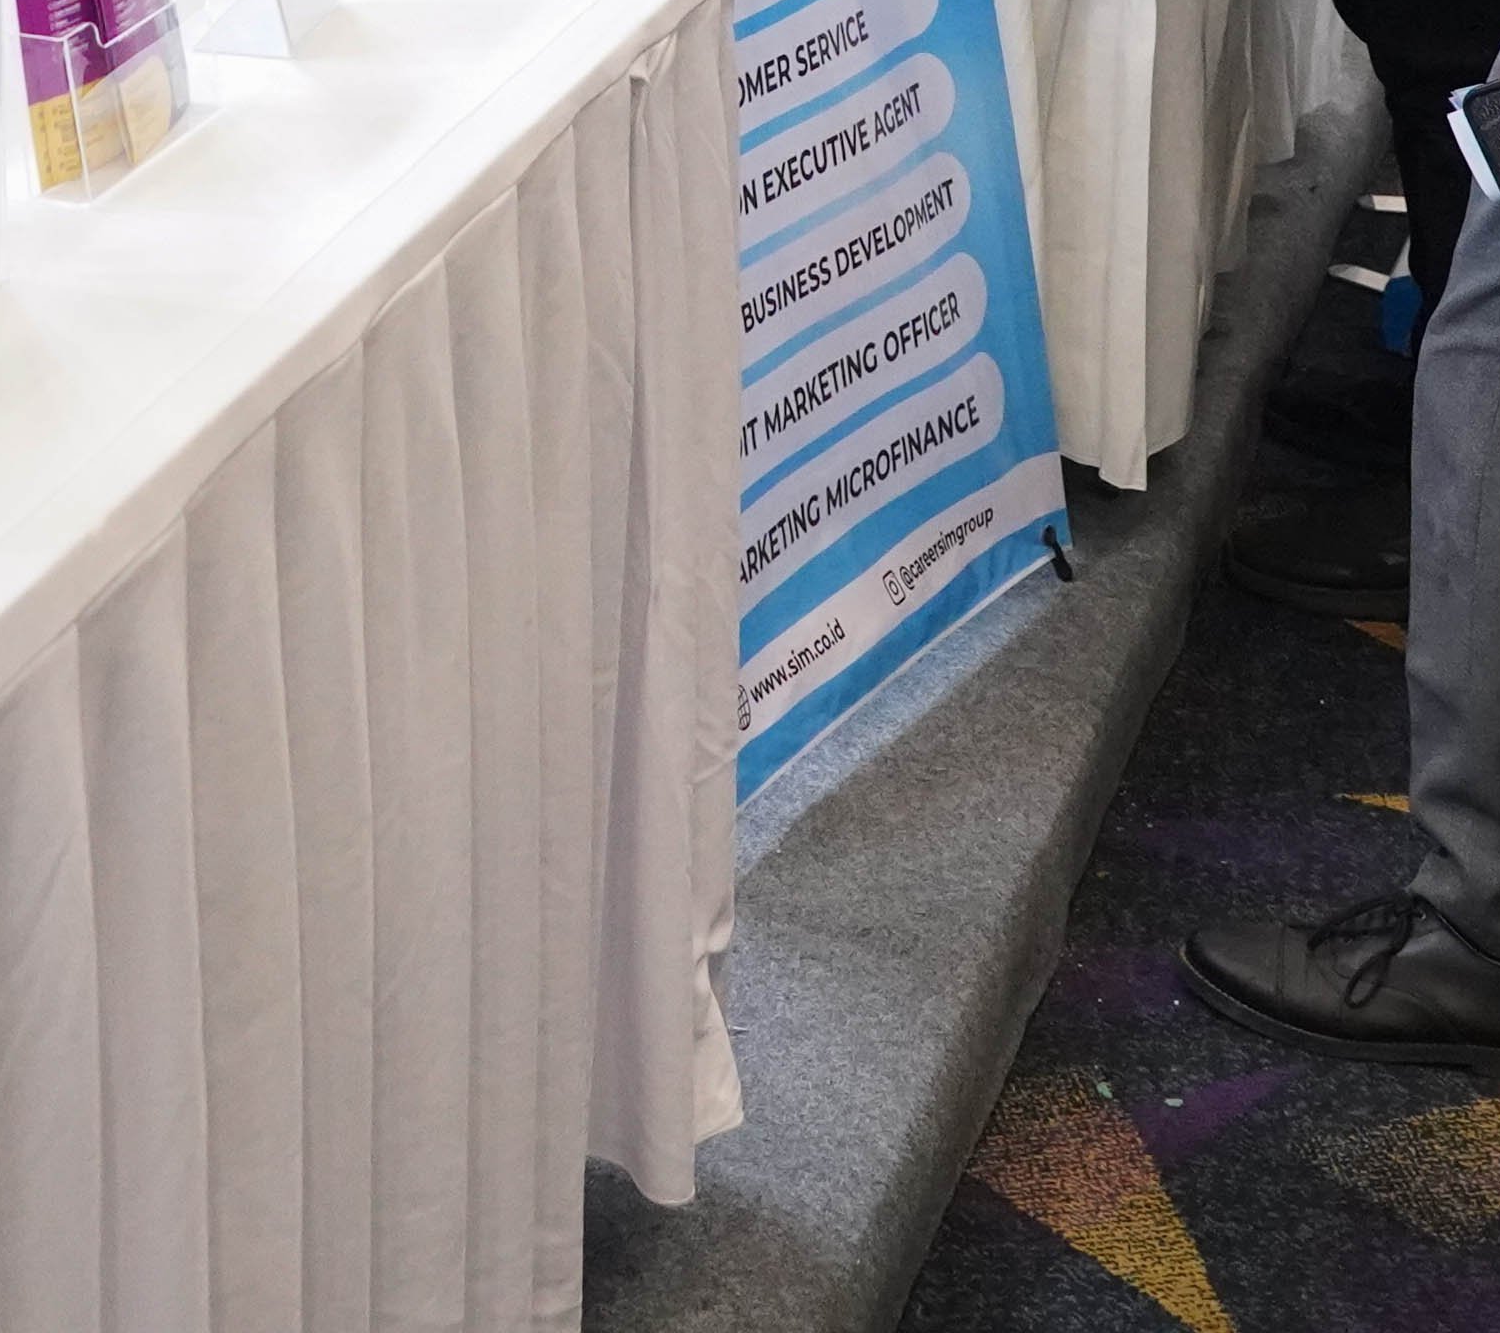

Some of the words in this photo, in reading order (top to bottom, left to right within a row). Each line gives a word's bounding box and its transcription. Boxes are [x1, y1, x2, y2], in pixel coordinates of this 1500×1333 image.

[795, 10, 869, 78] SERVICE
[739, 178, 758, 215] N
[762, 119, 870, 204] EXECUTIVE
[874, 83, 923, 145] AGENT
[741, 255, 832, 334] BUSINESS
[834, 178, 954, 278] DEVELOPMENT
[740, 416, 759, 459] IT
[763, 341, 878, 442] MARKETING
[883, 290, 961, 362] OFFICER
[826, 394, 980, 517] MICROFINANCE
[750, 617, 847, 704] www.sim.co.id
[899, 506, 994, 591] @careersimgroup
